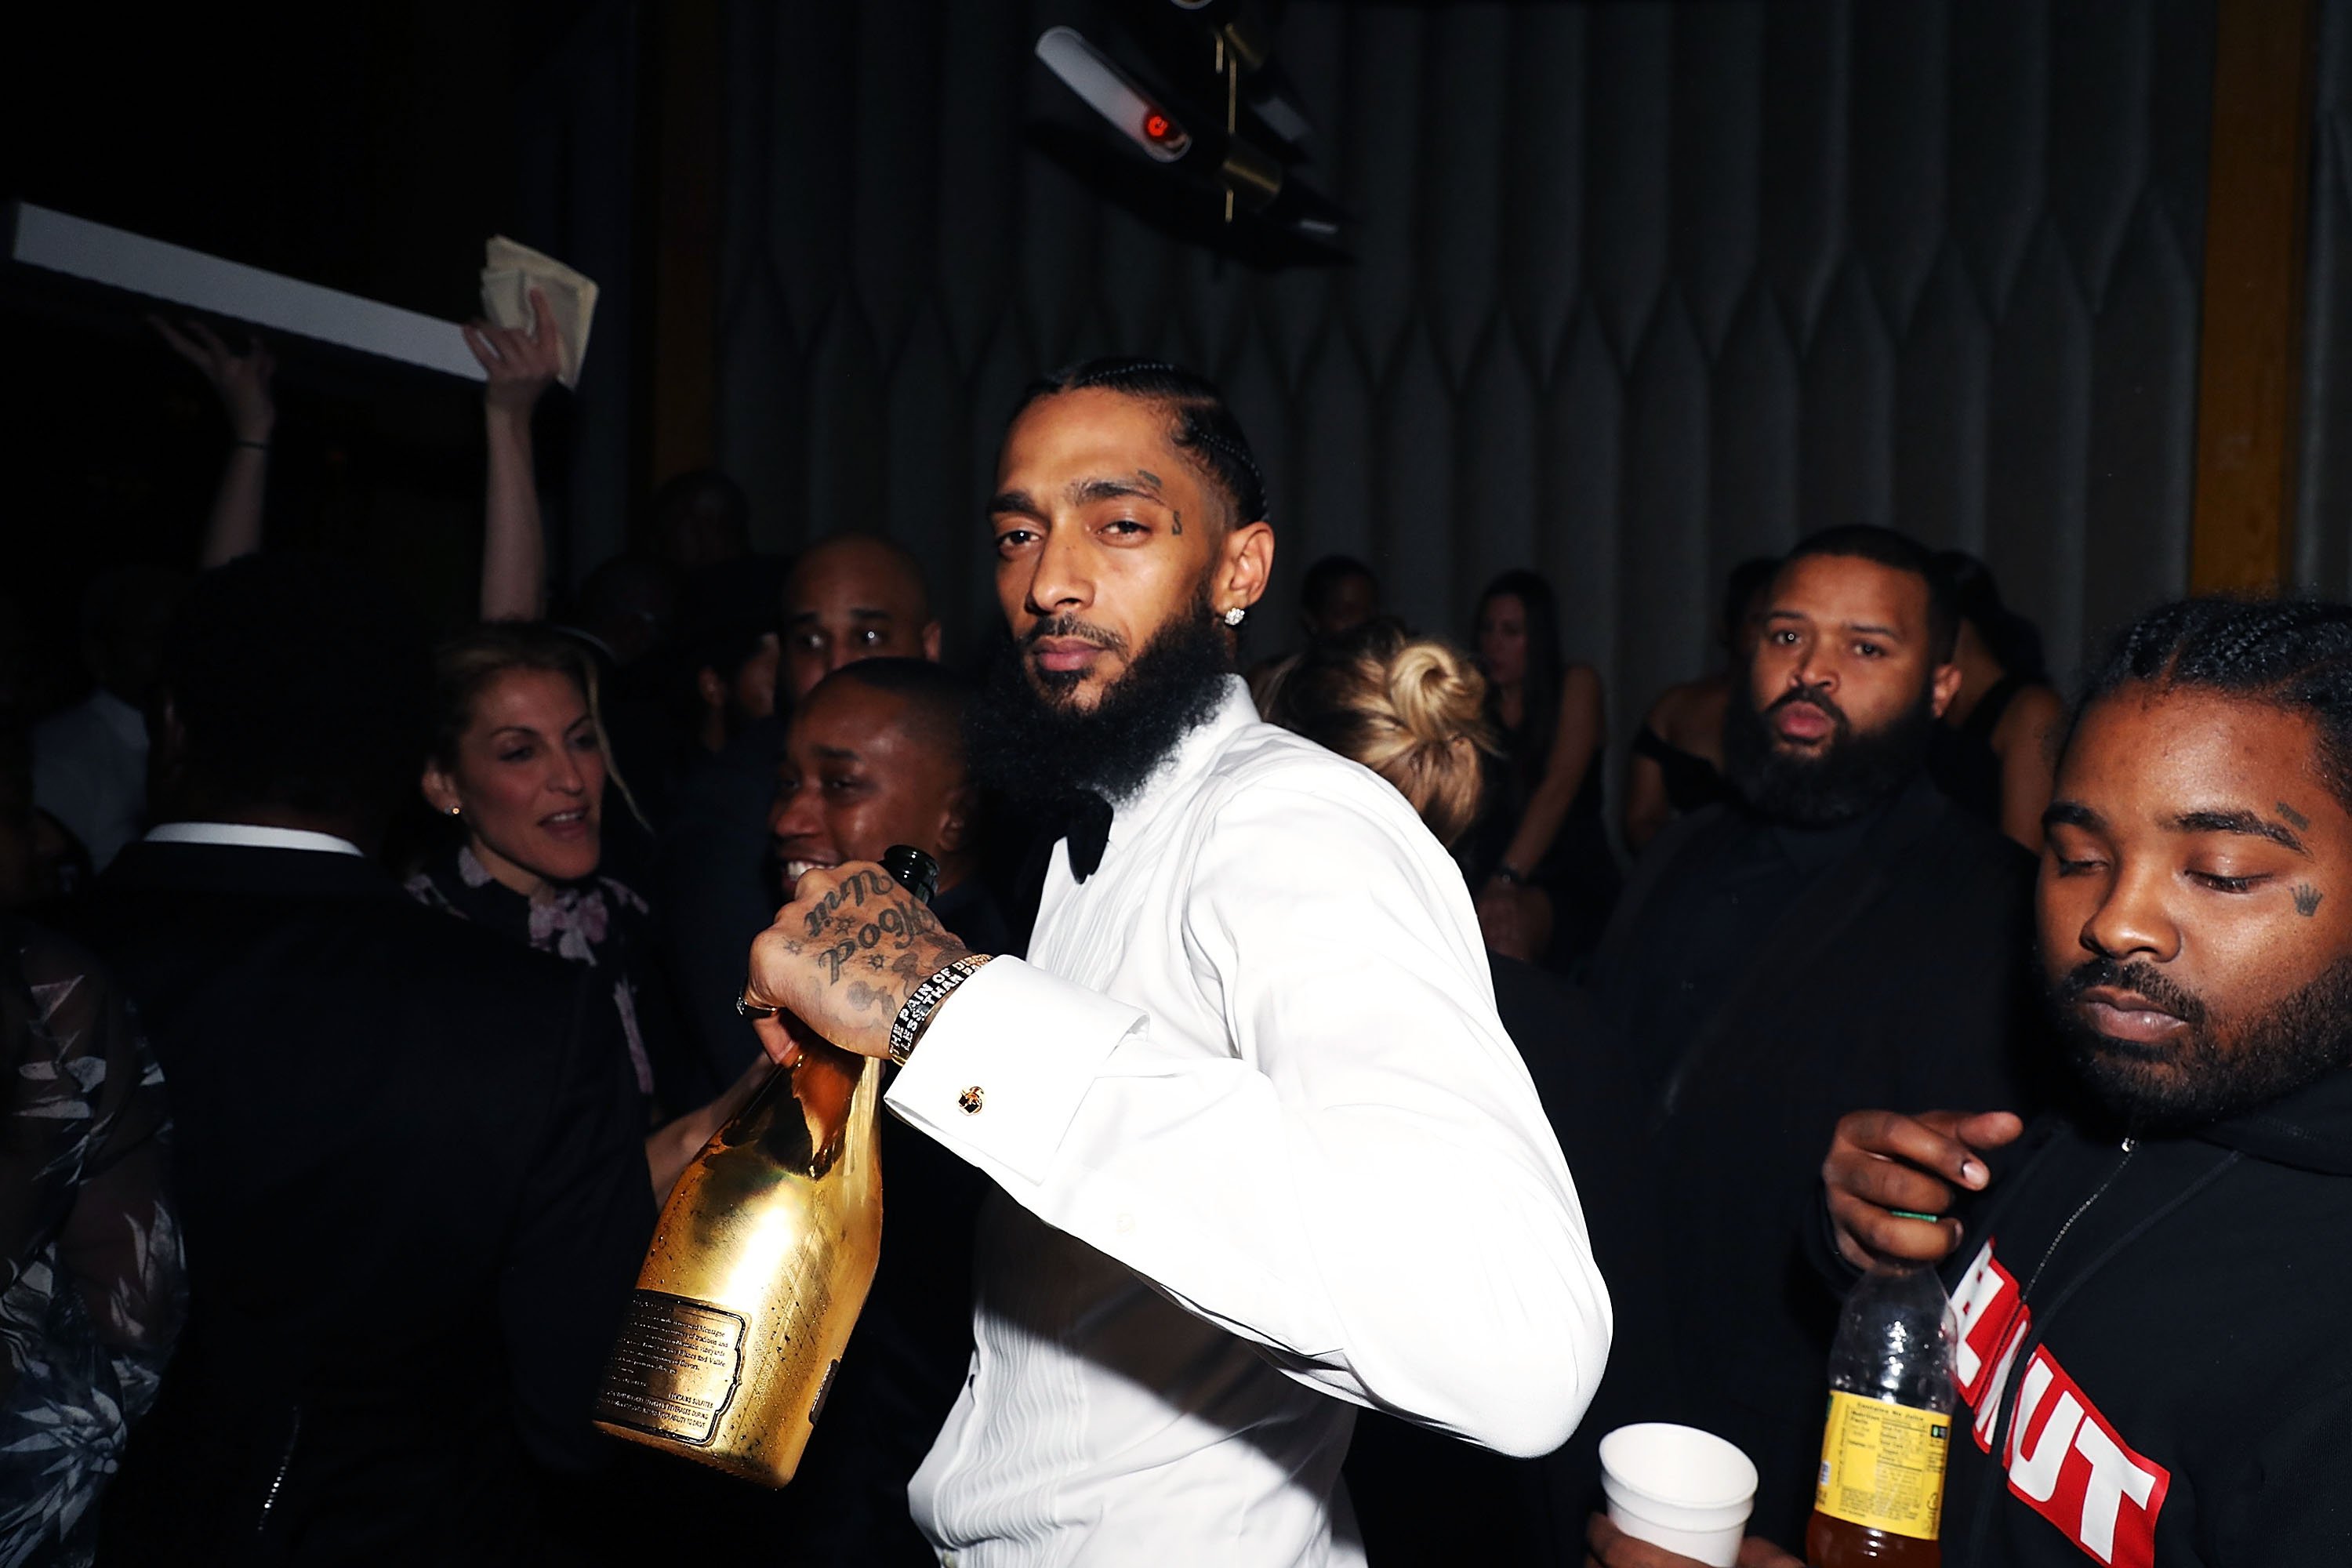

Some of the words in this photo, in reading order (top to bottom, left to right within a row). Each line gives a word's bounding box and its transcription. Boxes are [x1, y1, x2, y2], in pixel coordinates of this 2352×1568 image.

[889, 1022, 905, 1055] THE
[899, 982, 934, 1022] PAIN
[931, 967, 953, 984] OF
[922, 972, 964, 1004] THAN
